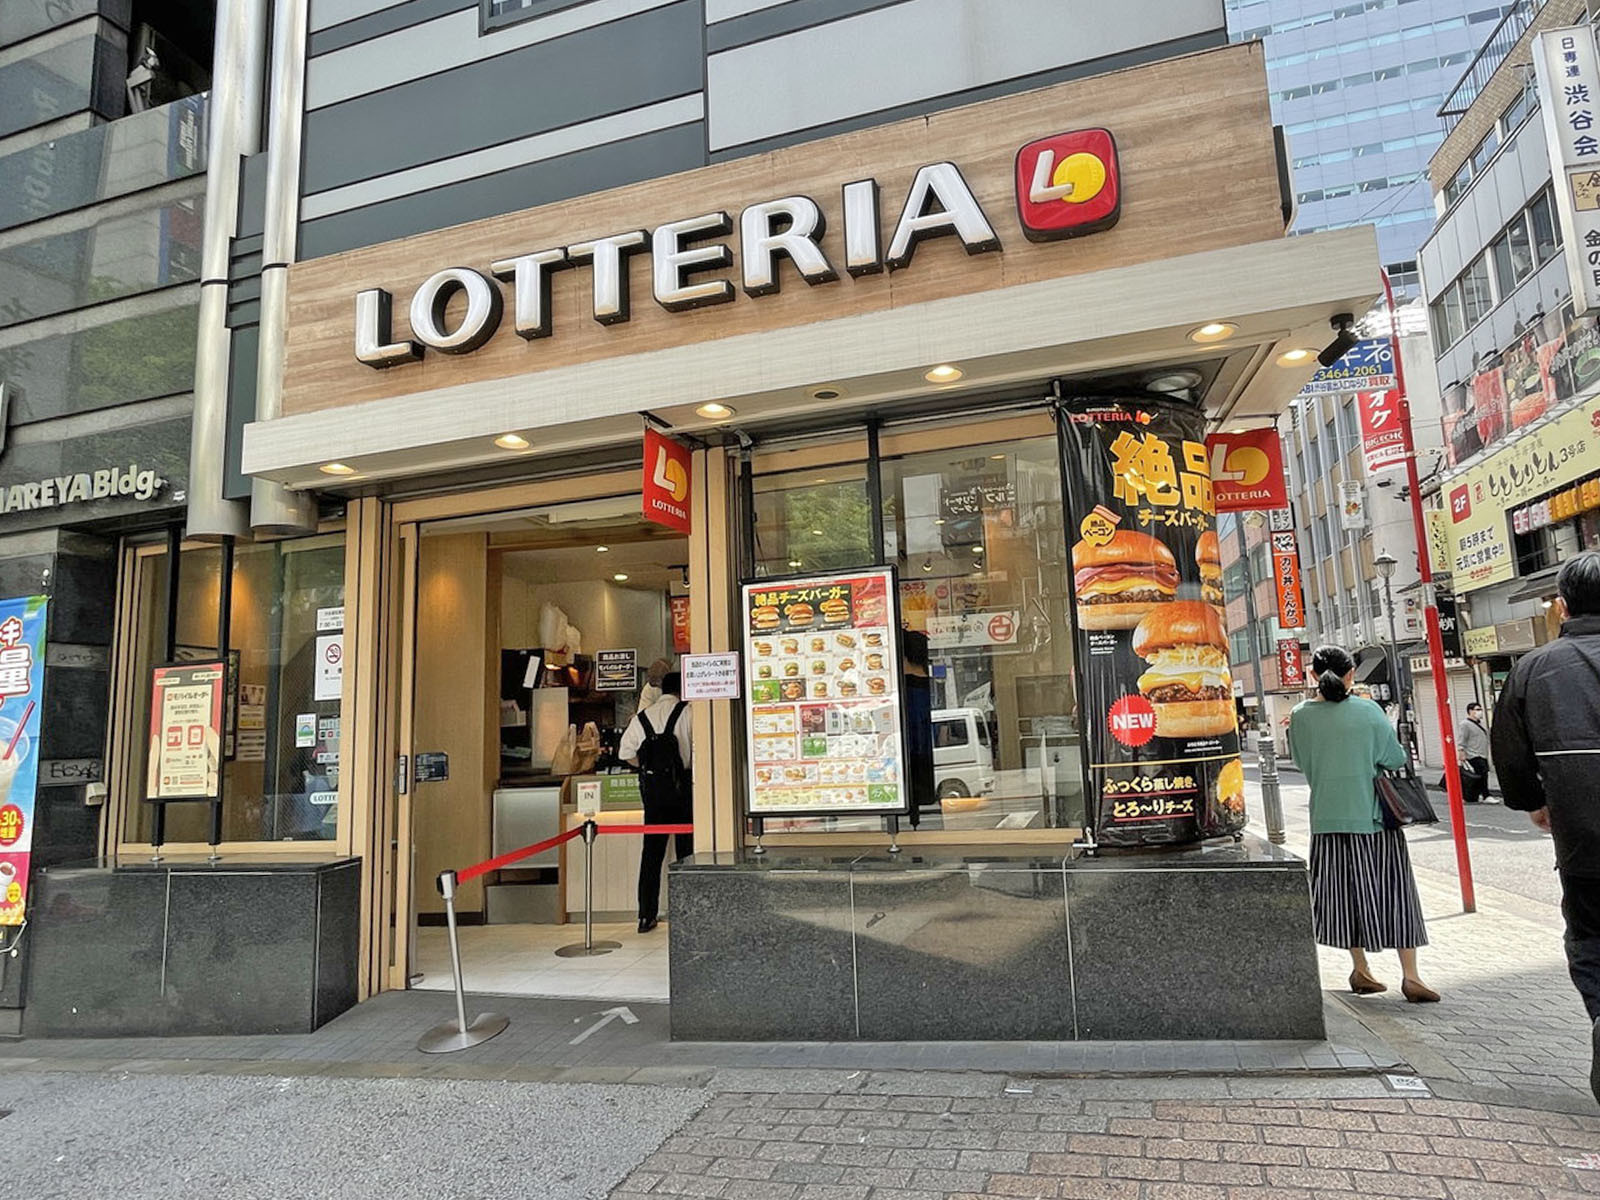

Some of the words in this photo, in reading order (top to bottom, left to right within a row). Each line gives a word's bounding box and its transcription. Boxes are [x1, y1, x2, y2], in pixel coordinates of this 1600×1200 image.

[1564, 83, 1599, 157] 渋谷会
[354, 161, 1000, 370] LOTTERIA
[1311, 364, 1382, 382] -3464-2061
[1071, 411, 1133, 423] LOTTERIA
[93, 465, 161, 500] Bldg.
[1215, 490, 1271, 502] OTTERIA
[1453, 494, 1467, 513] 2F
[652, 498, 687, 519] LOTTERIA
[1084, 527, 1113, 537] ベーコン
[755, 586, 849, 607] 絶品チーズバーガー
[1113, 713, 1153, 730] NEW
[584, 791, 595, 799] IN
